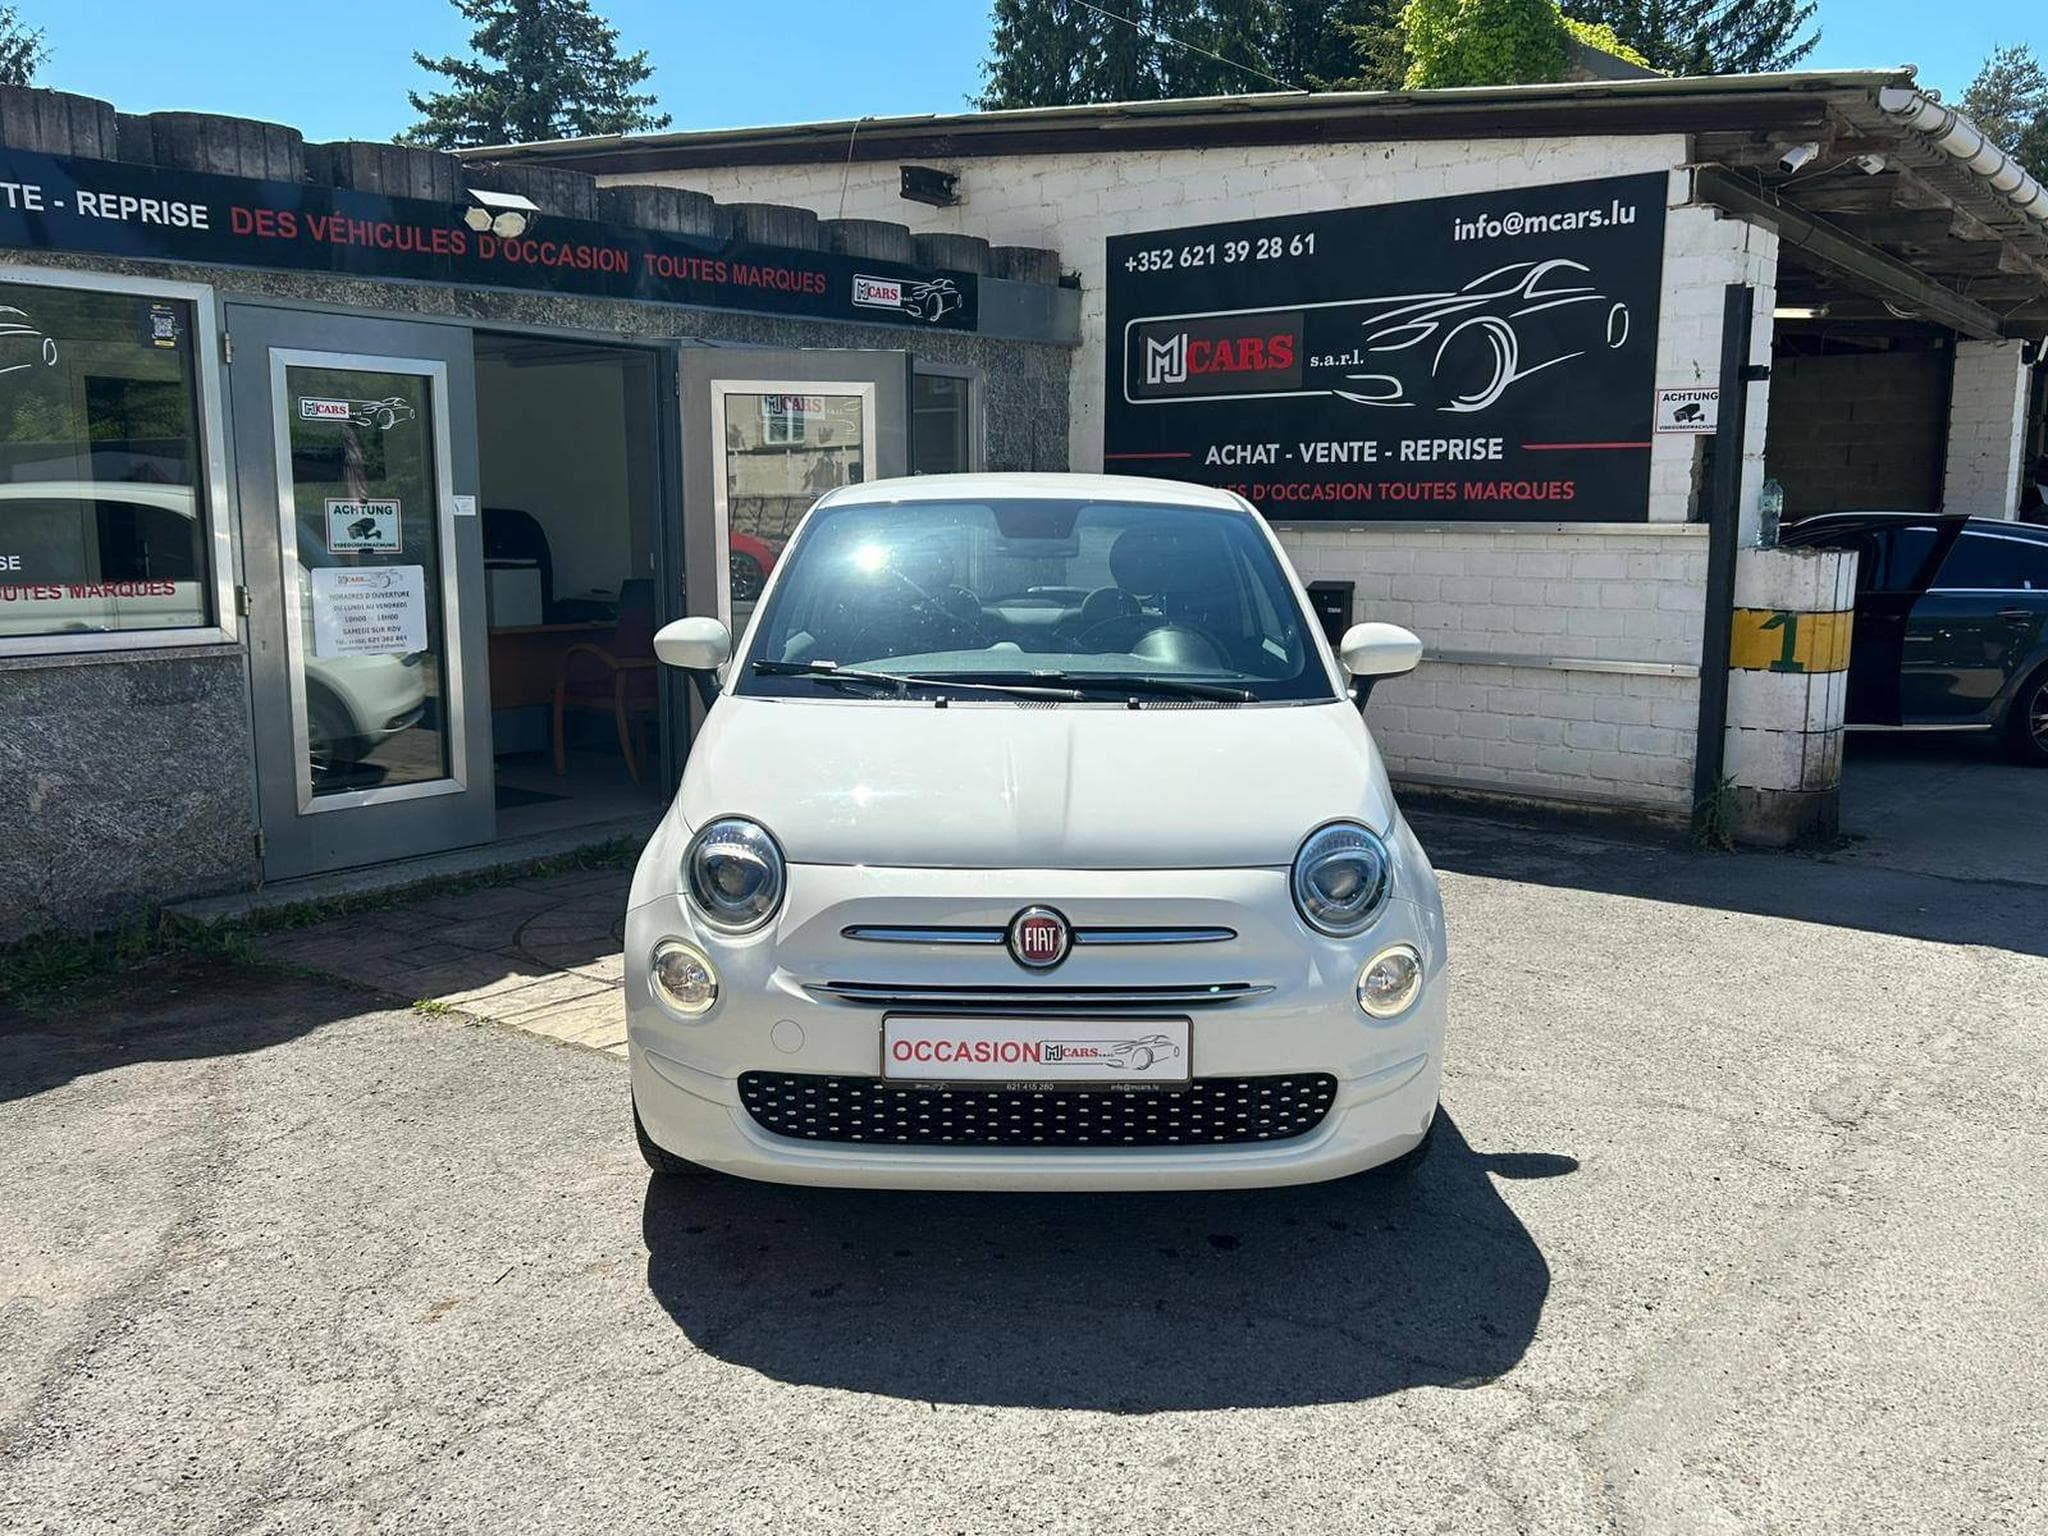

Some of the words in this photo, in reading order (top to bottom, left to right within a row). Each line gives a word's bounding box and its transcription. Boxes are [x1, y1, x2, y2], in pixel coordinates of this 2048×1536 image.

[1453, 200, 1637, 243] info@mcars.lu
[75, 189, 210, 230] REPRISE
[230, 206, 299, 240] DES
[305, 210, 467, 256] VÉHICULES
[478, 234, 629, 274] D'OCCASION
[645, 253, 728, 284] TOUTES
[731, 263, 827, 295] MARQUES
[1124, 248, 1174, 273] +352
[1179, 244, 1216, 268] 621
[1223, 240, 1250, 263] 39
[1256, 236, 1283, 260] 28
[1289, 232, 1315, 257] 61
[1310, 351, 1365, 368] s.a.r.l.
[1662, 391, 1719, 402] ACHTUNG
[1204, 443, 1281, 466] ACHAT
[1299, 441, 1378, 464] VENTE
[1400, 438, 1504, 462] REPRISE
[1252, 482, 1373, 501] D'OCCASION
[1378, 482, 1457, 500] TOUTES
[1463, 481, 1575, 500] MARQUES
[333, 504, 393, 515] ACHTUNG
[0, 584, 62, 601] UTES
[70, 581, 176, 599] MARQUES
[1759, 614, 1806, 672] 1
[1024, 927, 1056, 952] FIAT
[892, 1040, 1041, 1063] OCCASION
